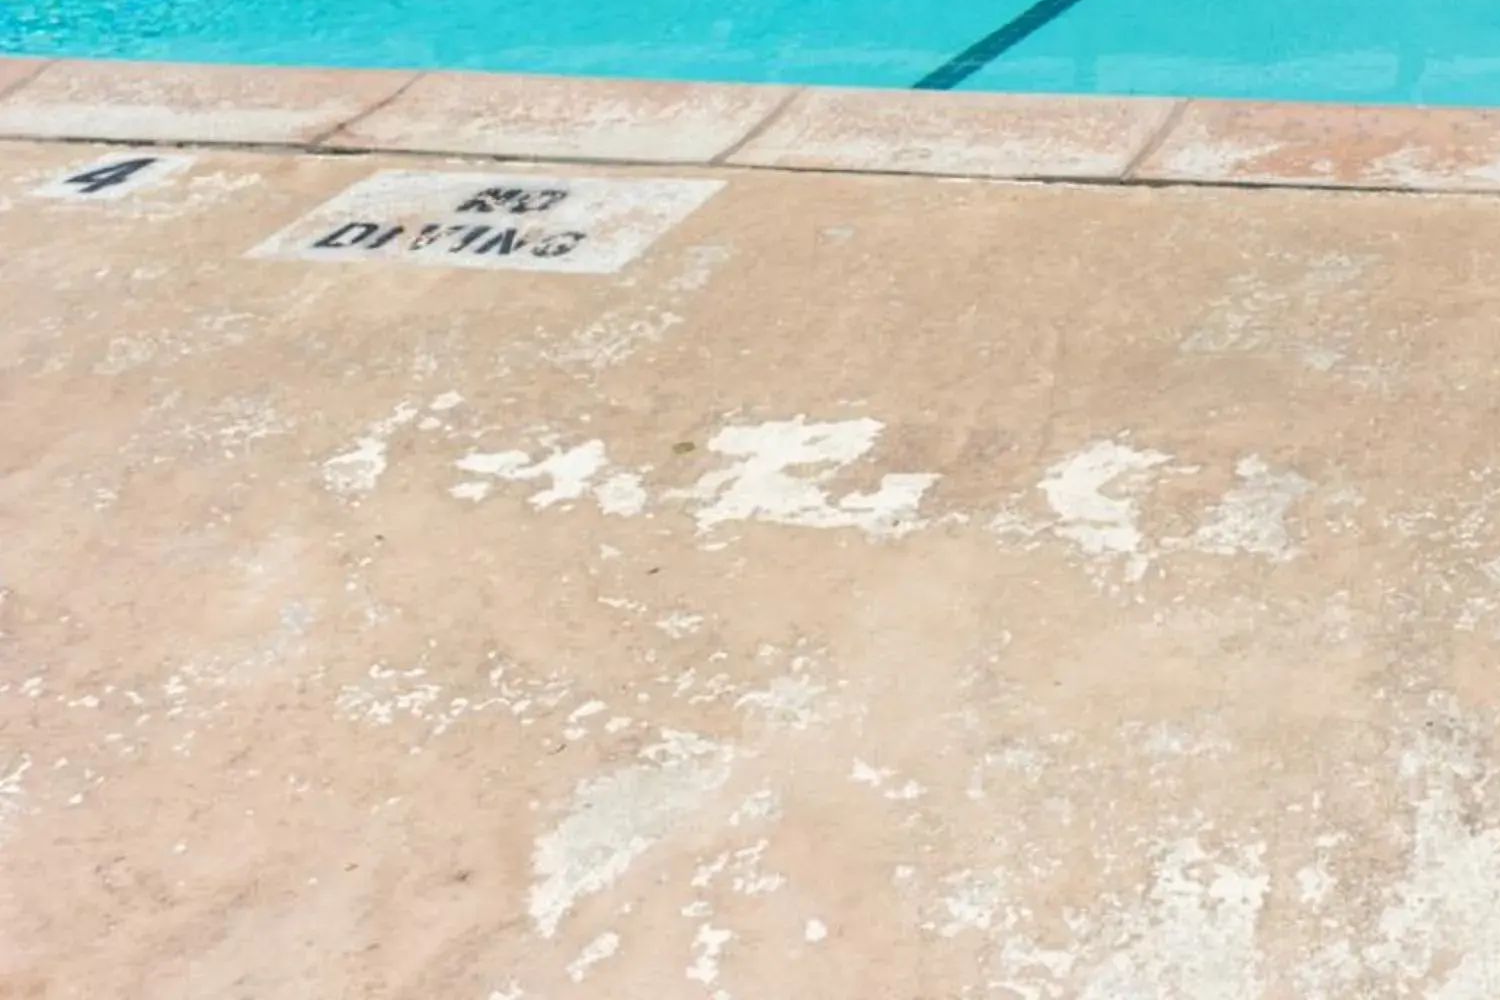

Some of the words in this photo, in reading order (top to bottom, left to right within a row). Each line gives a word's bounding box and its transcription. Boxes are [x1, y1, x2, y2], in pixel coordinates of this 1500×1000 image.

[63, 157, 159, 194] 4
[455, 187, 568, 213] NO
[311, 222, 586, 257] DIVING
